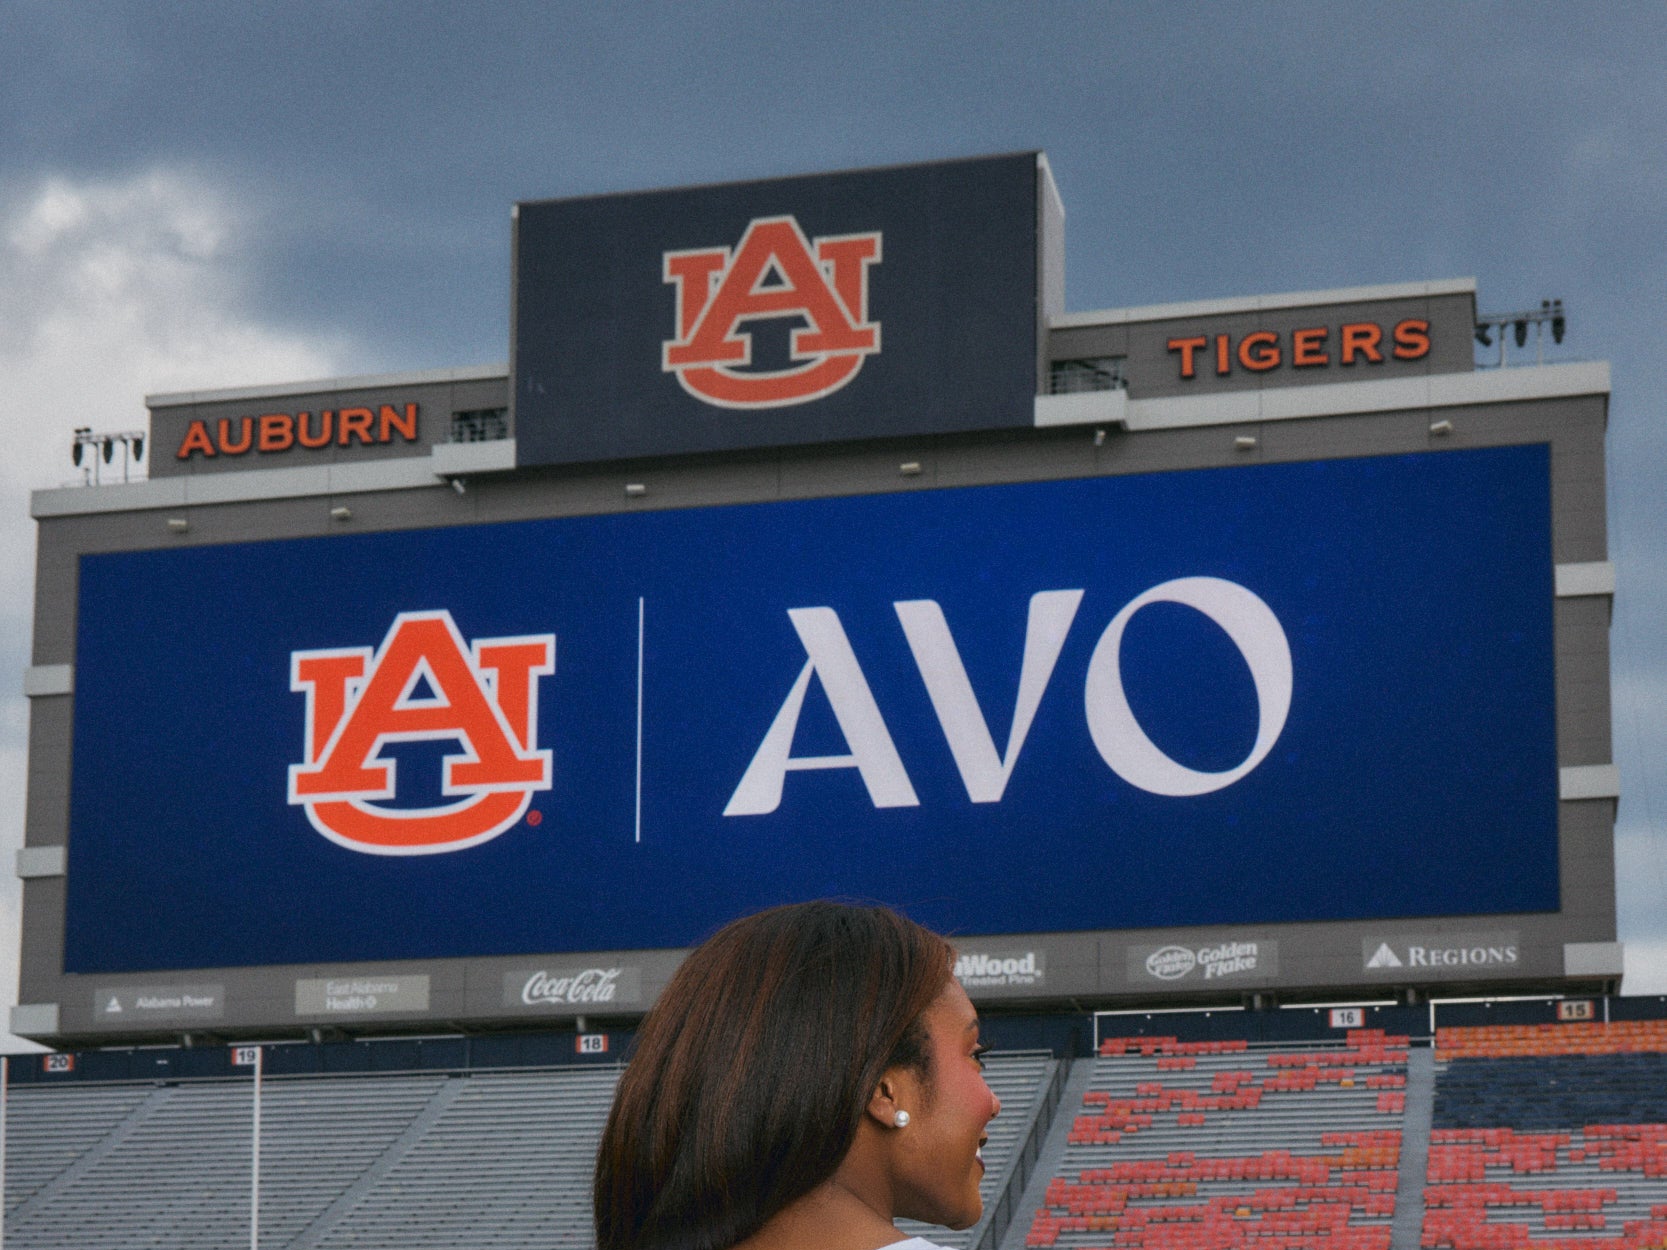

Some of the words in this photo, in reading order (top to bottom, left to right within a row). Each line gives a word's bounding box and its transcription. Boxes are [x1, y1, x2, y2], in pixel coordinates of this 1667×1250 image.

[1167, 319, 1431, 378] TIGERS
[176, 403, 418, 459] AUBURN
[722, 576, 1293, 817] AVO
[1198, 942, 1258, 965] Golden
[1408, 946, 1517, 967] REGIONS
[1204, 956, 1257, 979] Flake
[521, 968, 622, 1004] Coca-Cola
[135, 997, 181, 1008] Alabama
[182, 995, 214, 1007] Power
[325, 995, 364, 1010] Health
[1564, 1003, 1586, 1017] 15
[1340, 1011, 1354, 1024] 16
[583, 1037, 600, 1050] 18
[50, 1055, 67, 1069] 20
[239, 1050, 256, 1063] 19
